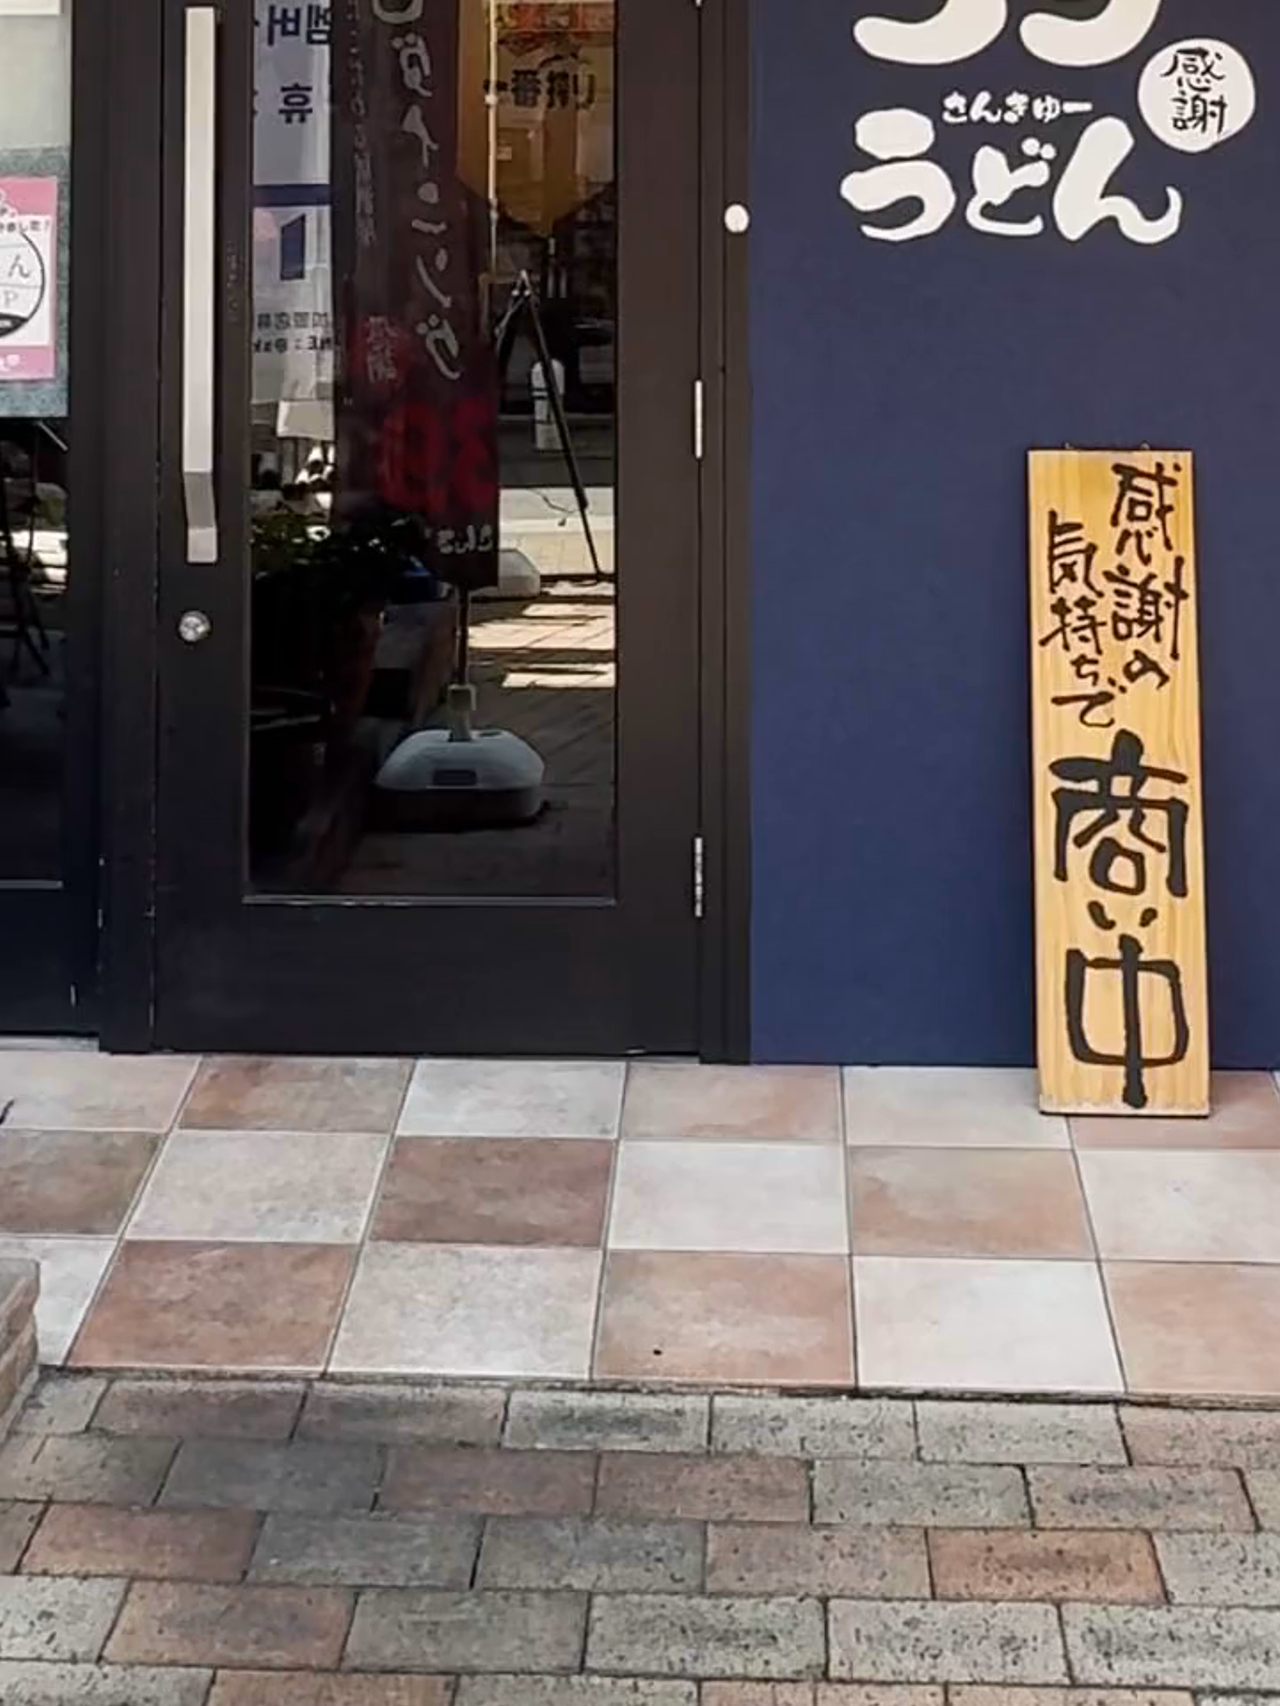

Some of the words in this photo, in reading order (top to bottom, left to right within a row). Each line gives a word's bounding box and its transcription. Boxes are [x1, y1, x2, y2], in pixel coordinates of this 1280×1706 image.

[839, 108, 1183, 245] うどん
[942, 91, 1093, 126] さんきゅー
[1159, 45, 1228, 137] 感謝
[1038, 509, 1127, 729] 気持ちで
[1102, 460, 1189, 691] 感謝の
[1047, 728, 1191, 1109] 商い中
